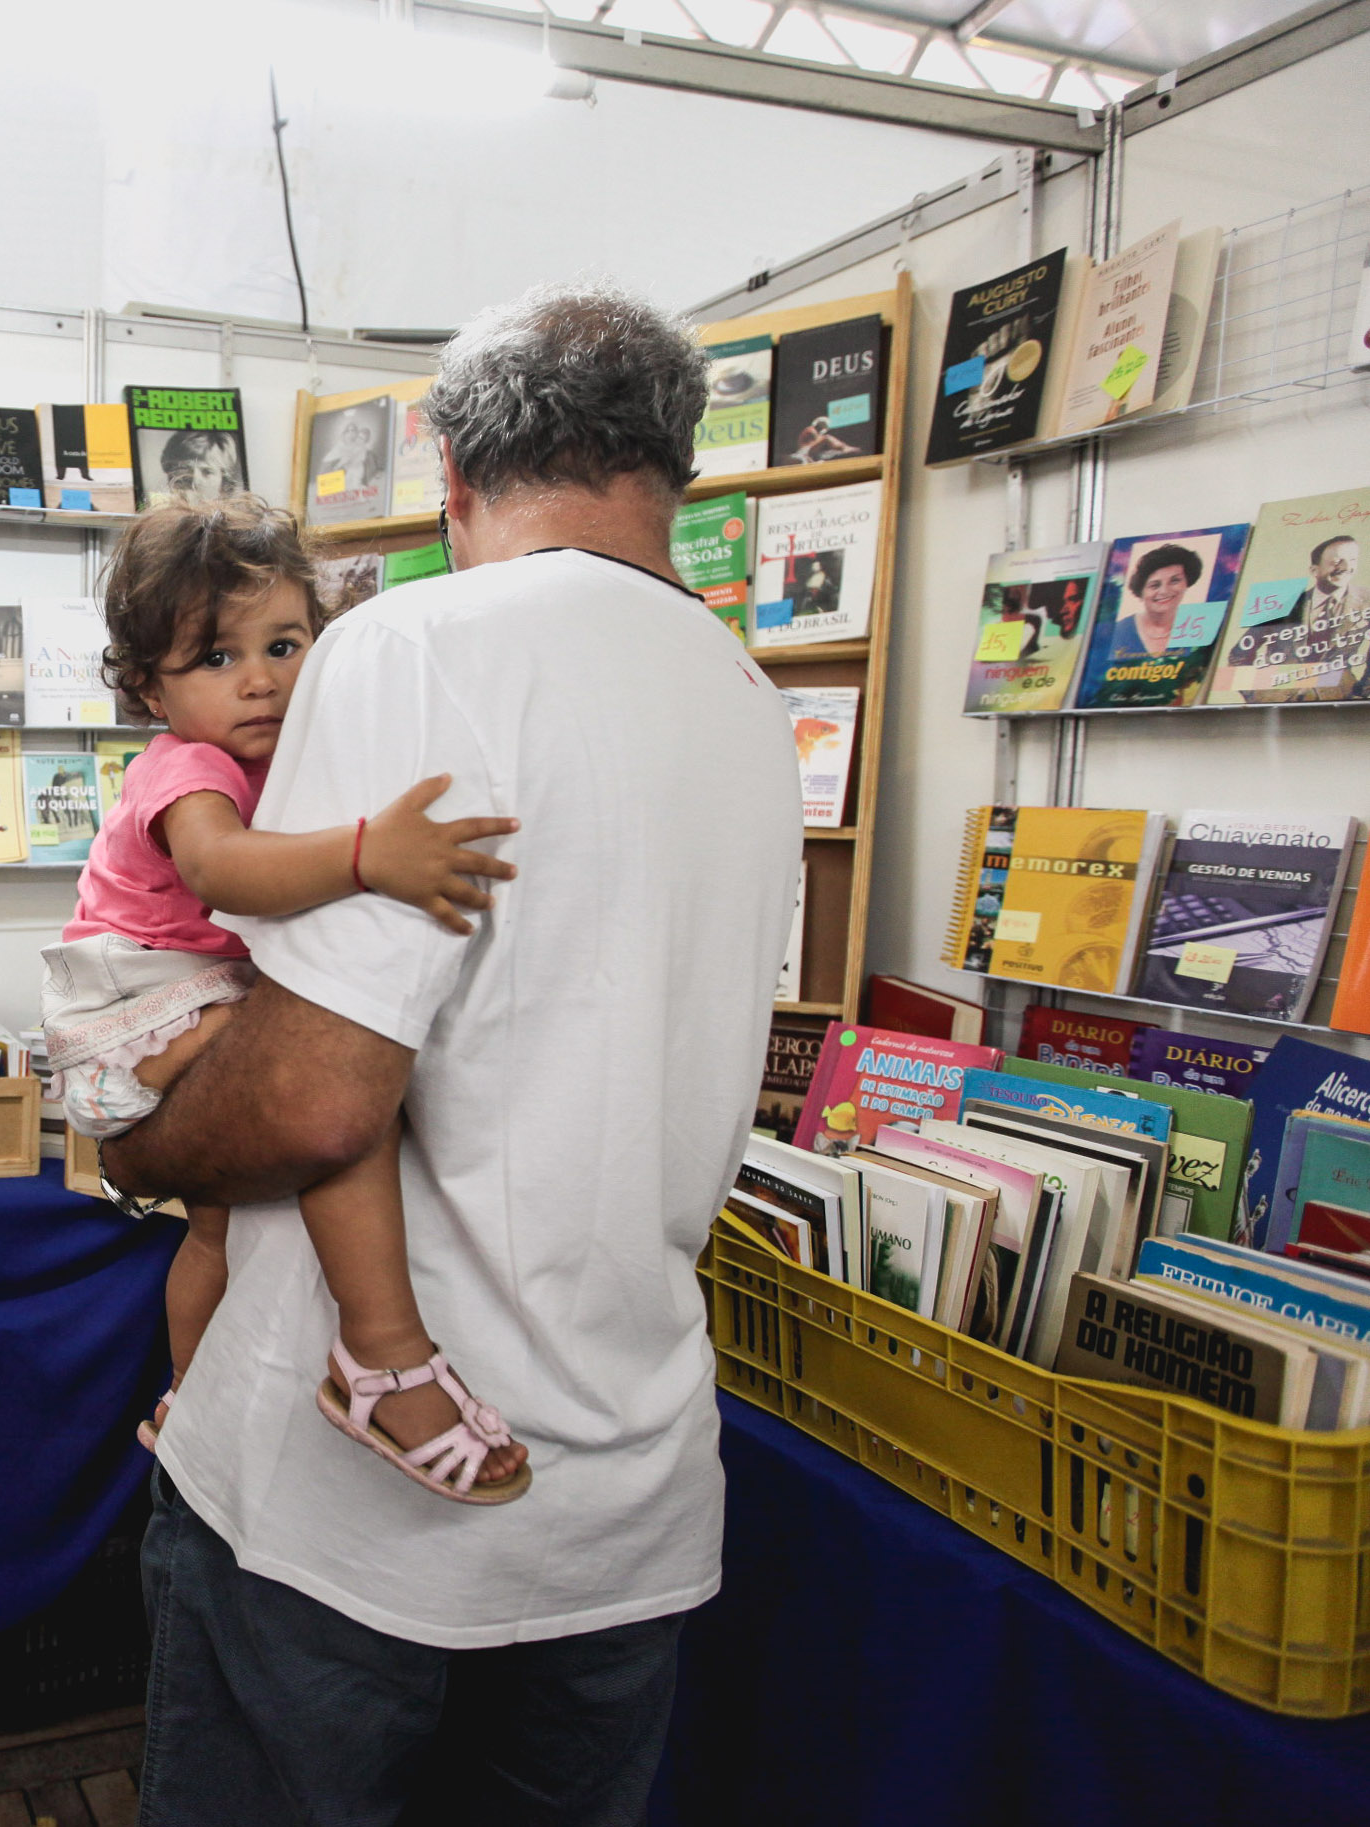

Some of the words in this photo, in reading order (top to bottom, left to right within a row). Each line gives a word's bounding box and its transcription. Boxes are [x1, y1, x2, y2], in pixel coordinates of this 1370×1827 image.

[967, 265, 1048, 308] AUGUSTO
[982, 289, 1029, 316] CURY
[812, 350, 874, 380] DEUS
[147, 389, 236, 410] ROBERT
[133, 408, 239, 430] REDFORD
[767, 511, 870, 536] RESTAURAÇÃO
[775, 533, 859, 554] PORTUGAL
[803, 613, 853, 631] BRASIL
[1239, 635, 1255, 651] O
[37, 647, 51, 661] A
[1253, 650, 1287, 669] do
[29, 663, 54, 678] Era
[1105, 661, 1186, 682] contigo!
[1270, 652, 1365, 687] mundo
[1034, 675, 1055, 688] de
[30, 785, 67, 797] ANTES
[70, 785, 97, 797] QUE
[49, 799, 98, 811] QUEIME
[1188, 822, 1331, 849] Chiavenato
[986, 854, 1125, 878] memorex
[1188, 863, 1237, 877] GESTÃO
[1237, 866, 1256, 878] DE
[1258, 869, 1312, 883] VENDAS
[855, 1047, 965, 1091] ANIMAIS
[1165, 1045, 1254, 1074] DIÁRIO
[1182, 1068, 1199, 1081] de
[1202, 1073, 1226, 1086] um
[860, 1078, 876, 1093] DE
[877, 1083, 945, 1108] ESTIMAÇÃO
[990, 1087, 1048, 1107] TESOURO
[860, 1094, 870, 1108] E
[870, 1097, 889, 1111] DO
[891, 1102, 934, 1119] CAMPO
[1167, 1183, 1195, 1196] TEMPOS
[1085, 1289, 1107, 1324] A
[1112, 1298, 1254, 1380] RELIGIÃO
[1076, 1318, 1117, 1361] DO
[1124, 1336, 1257, 1418] HOMEM
